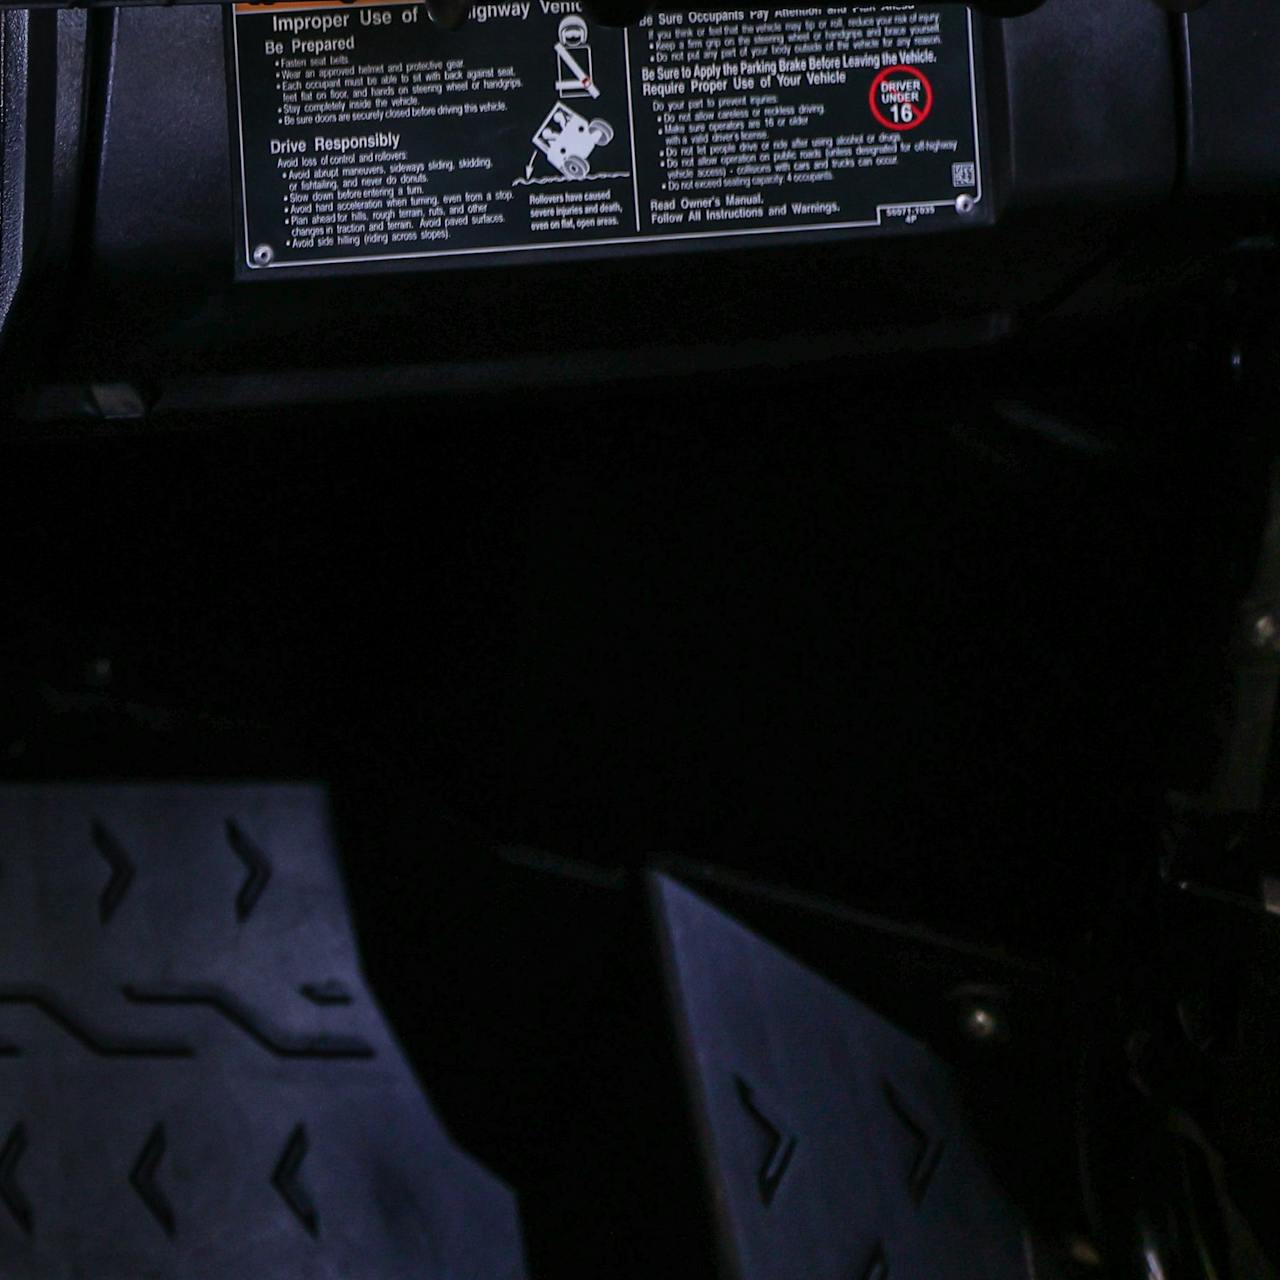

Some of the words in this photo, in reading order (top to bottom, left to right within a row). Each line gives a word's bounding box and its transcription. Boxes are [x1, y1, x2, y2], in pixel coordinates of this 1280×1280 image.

[272, 14, 350, 34] Improper
[360, 9, 392, 26] Use
[402, 6, 418, 23] of
[658, 12, 683, 26] Sure
[688, 10, 744, 24] Occupants
[265, 41, 284, 55] Be
[291, 34, 355, 55] Prepared
[641, 66, 656, 82] Be
[656, 66, 680, 81] Sure
[681, 65, 692, 79] to
[693, 60, 721, 80] Apply
[722, 60, 738, 76] the
[740, 59, 777, 77] Parking
[778, 56, 807, 73] Brake
[808, 54, 841, 71] Before
[842, 53, 880, 70] Leaving
[881, 51, 898, 66] the
[898, 48, 937, 65] Vehicle.
[642, 81, 685, 98] Require
[690, 79, 728, 95] Proper
[733, 77, 755, 90] Use
[760, 74, 772, 88] of
[776, 73, 802, 88] Your
[806, 70, 847, 86] Vehicle
[880, 79, 921, 93] DRIVER
[283, 103, 301, 115] Stay
[304, 101, 346, 112] completely
[349, 99, 372, 109] inside
[375, 98, 388, 108] the
[881, 91, 919, 104] UNDER
[284, 115, 295, 126] Be
[296, 116, 313, 125] sure
[315, 113, 337, 124] doors
[338, 113, 351, 122] are
[352, 110, 384, 122] securely
[385, 106, 410, 119] closed
[411, 104, 436, 117] before
[437, 104, 463, 117] driving
[464, 102, 478, 114] this
[890, 103, 913, 123] 16
[270, 139, 307, 154] Drive
[315, 131, 400, 153] Responsibly
[277, 158, 299, 169] Avoid
[301, 157, 318, 167] loss
[320, 154, 328, 165] of
[329, 153, 356, 165] control
[359, 152, 374, 163] and
[529, 193, 564, 205] Rollovers
[565, 192, 583, 203] have
[584, 189, 611, 200] caused
[650, 199, 676, 212] Read
[680, 196, 721, 210] Owner's
[725, 192, 764, 206] Manual.
[584, 204, 598, 214] and
[651, 211, 683, 225] Follow
[688, 210, 702, 222] All
[706, 207, 763, 221] Instructions
[768, 204, 787, 217] and
[792, 202, 840, 216] Warnings.
[531, 221, 549, 231] even
[550, 220, 560, 229] on
[576, 218, 595, 229] open
